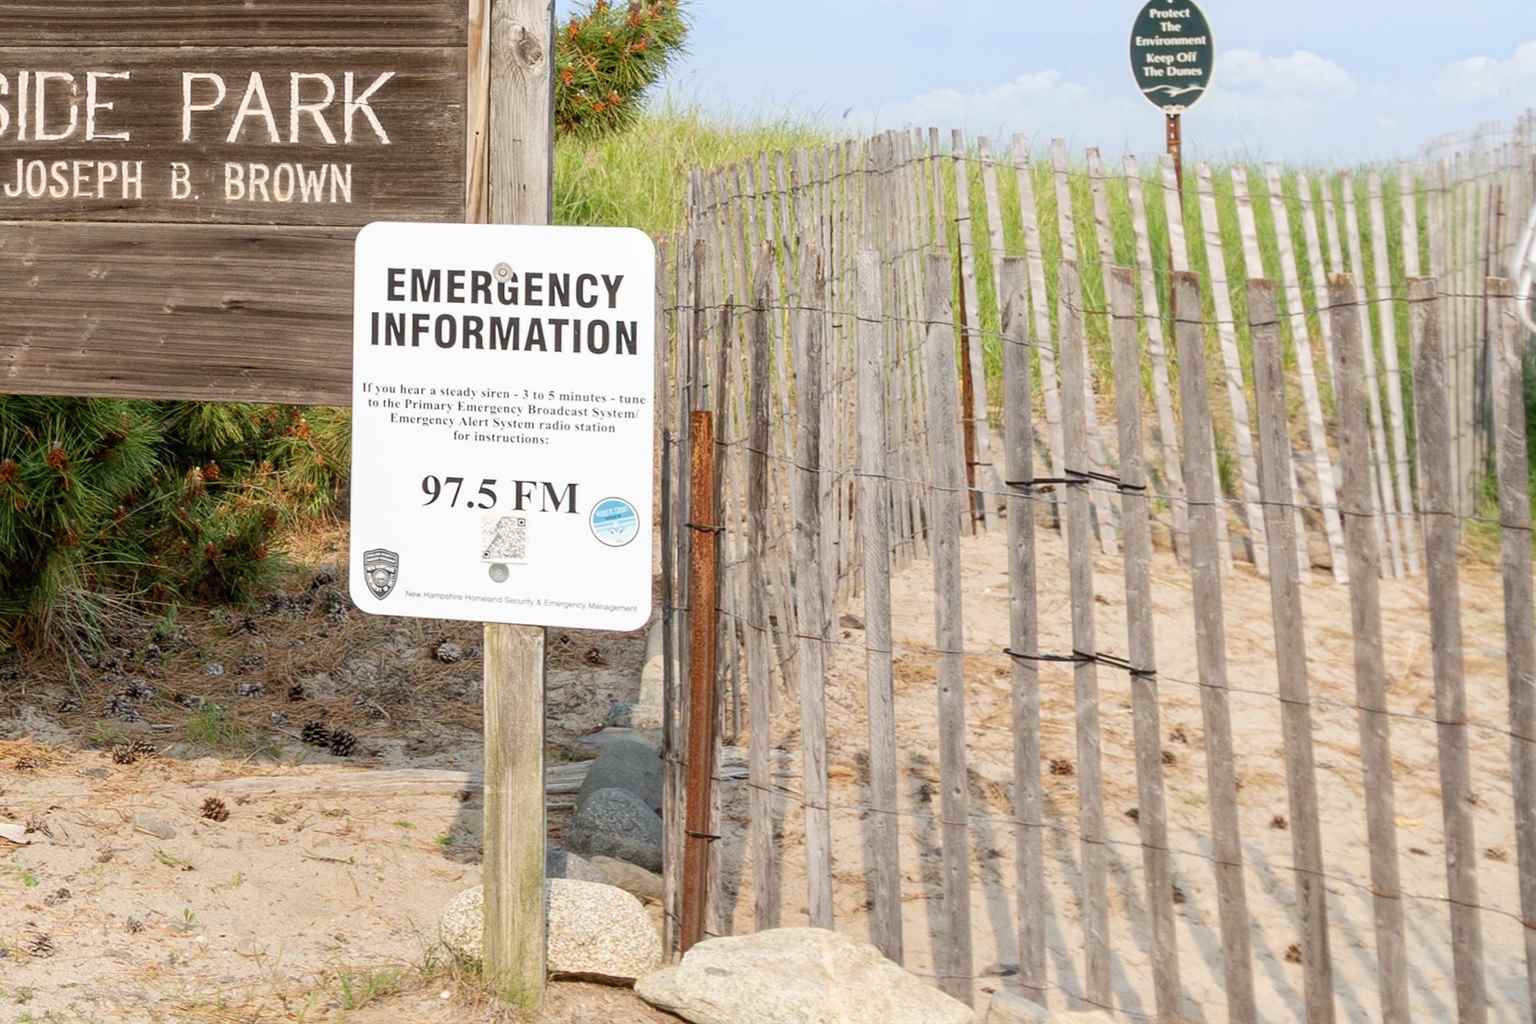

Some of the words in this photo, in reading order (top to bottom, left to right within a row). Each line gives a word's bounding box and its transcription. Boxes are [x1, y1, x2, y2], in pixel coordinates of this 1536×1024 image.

[1149, 8, 1191, 19] Protect
[1160, 22, 1182, 32] The
[1135, 36, 1206, 47] Environment
[1146, 53, 1174, 65] Keep
[1176, 52, 1198, 63] Off
[1142, 67, 1164, 77] The
[1166, 66, 1203, 77] Dunes
[182, 71, 396, 145] PARK
[4, 160, 143, 199] JOSEPH
[171, 162, 200, 201] B.
[224, 162, 353, 203] BROWN
[386, 267, 625, 309] EMERGENCY
[370, 311, 638, 355] INFORMATION
[363, 382, 373, 393] If
[375, 385, 396, 395] you
[400, 384, 426, 395] hear
[430, 387, 437, 395] a
[440, 387, 476, 399] steady
[481, 388, 510, 399] siren
[522, 389, 529, 400] 3
[533, 391, 544, 401] to
[548, 390, 556, 401] 5
[559, 392, 607, 403] minutes
[619, 395, 646, 405] tune
[368, 398, 379, 408] to
[383, 398, 401, 409] the
[405, 399, 452, 414] Primary
[458, 401, 523, 417] Emergency
[528, 405, 588, 417] Broadcast
[390, 413, 454, 428] Emergency
[460, 416, 489, 428] Alert
[493, 417, 535, 431] System
[539, 420, 571, 432] radio
[574, 422, 616, 433] station
[454, 431, 470, 441] for
[474, 432, 549, 445] instructions:
[421, 475, 498, 510] 97.5
[512, 480, 581, 514] FM
